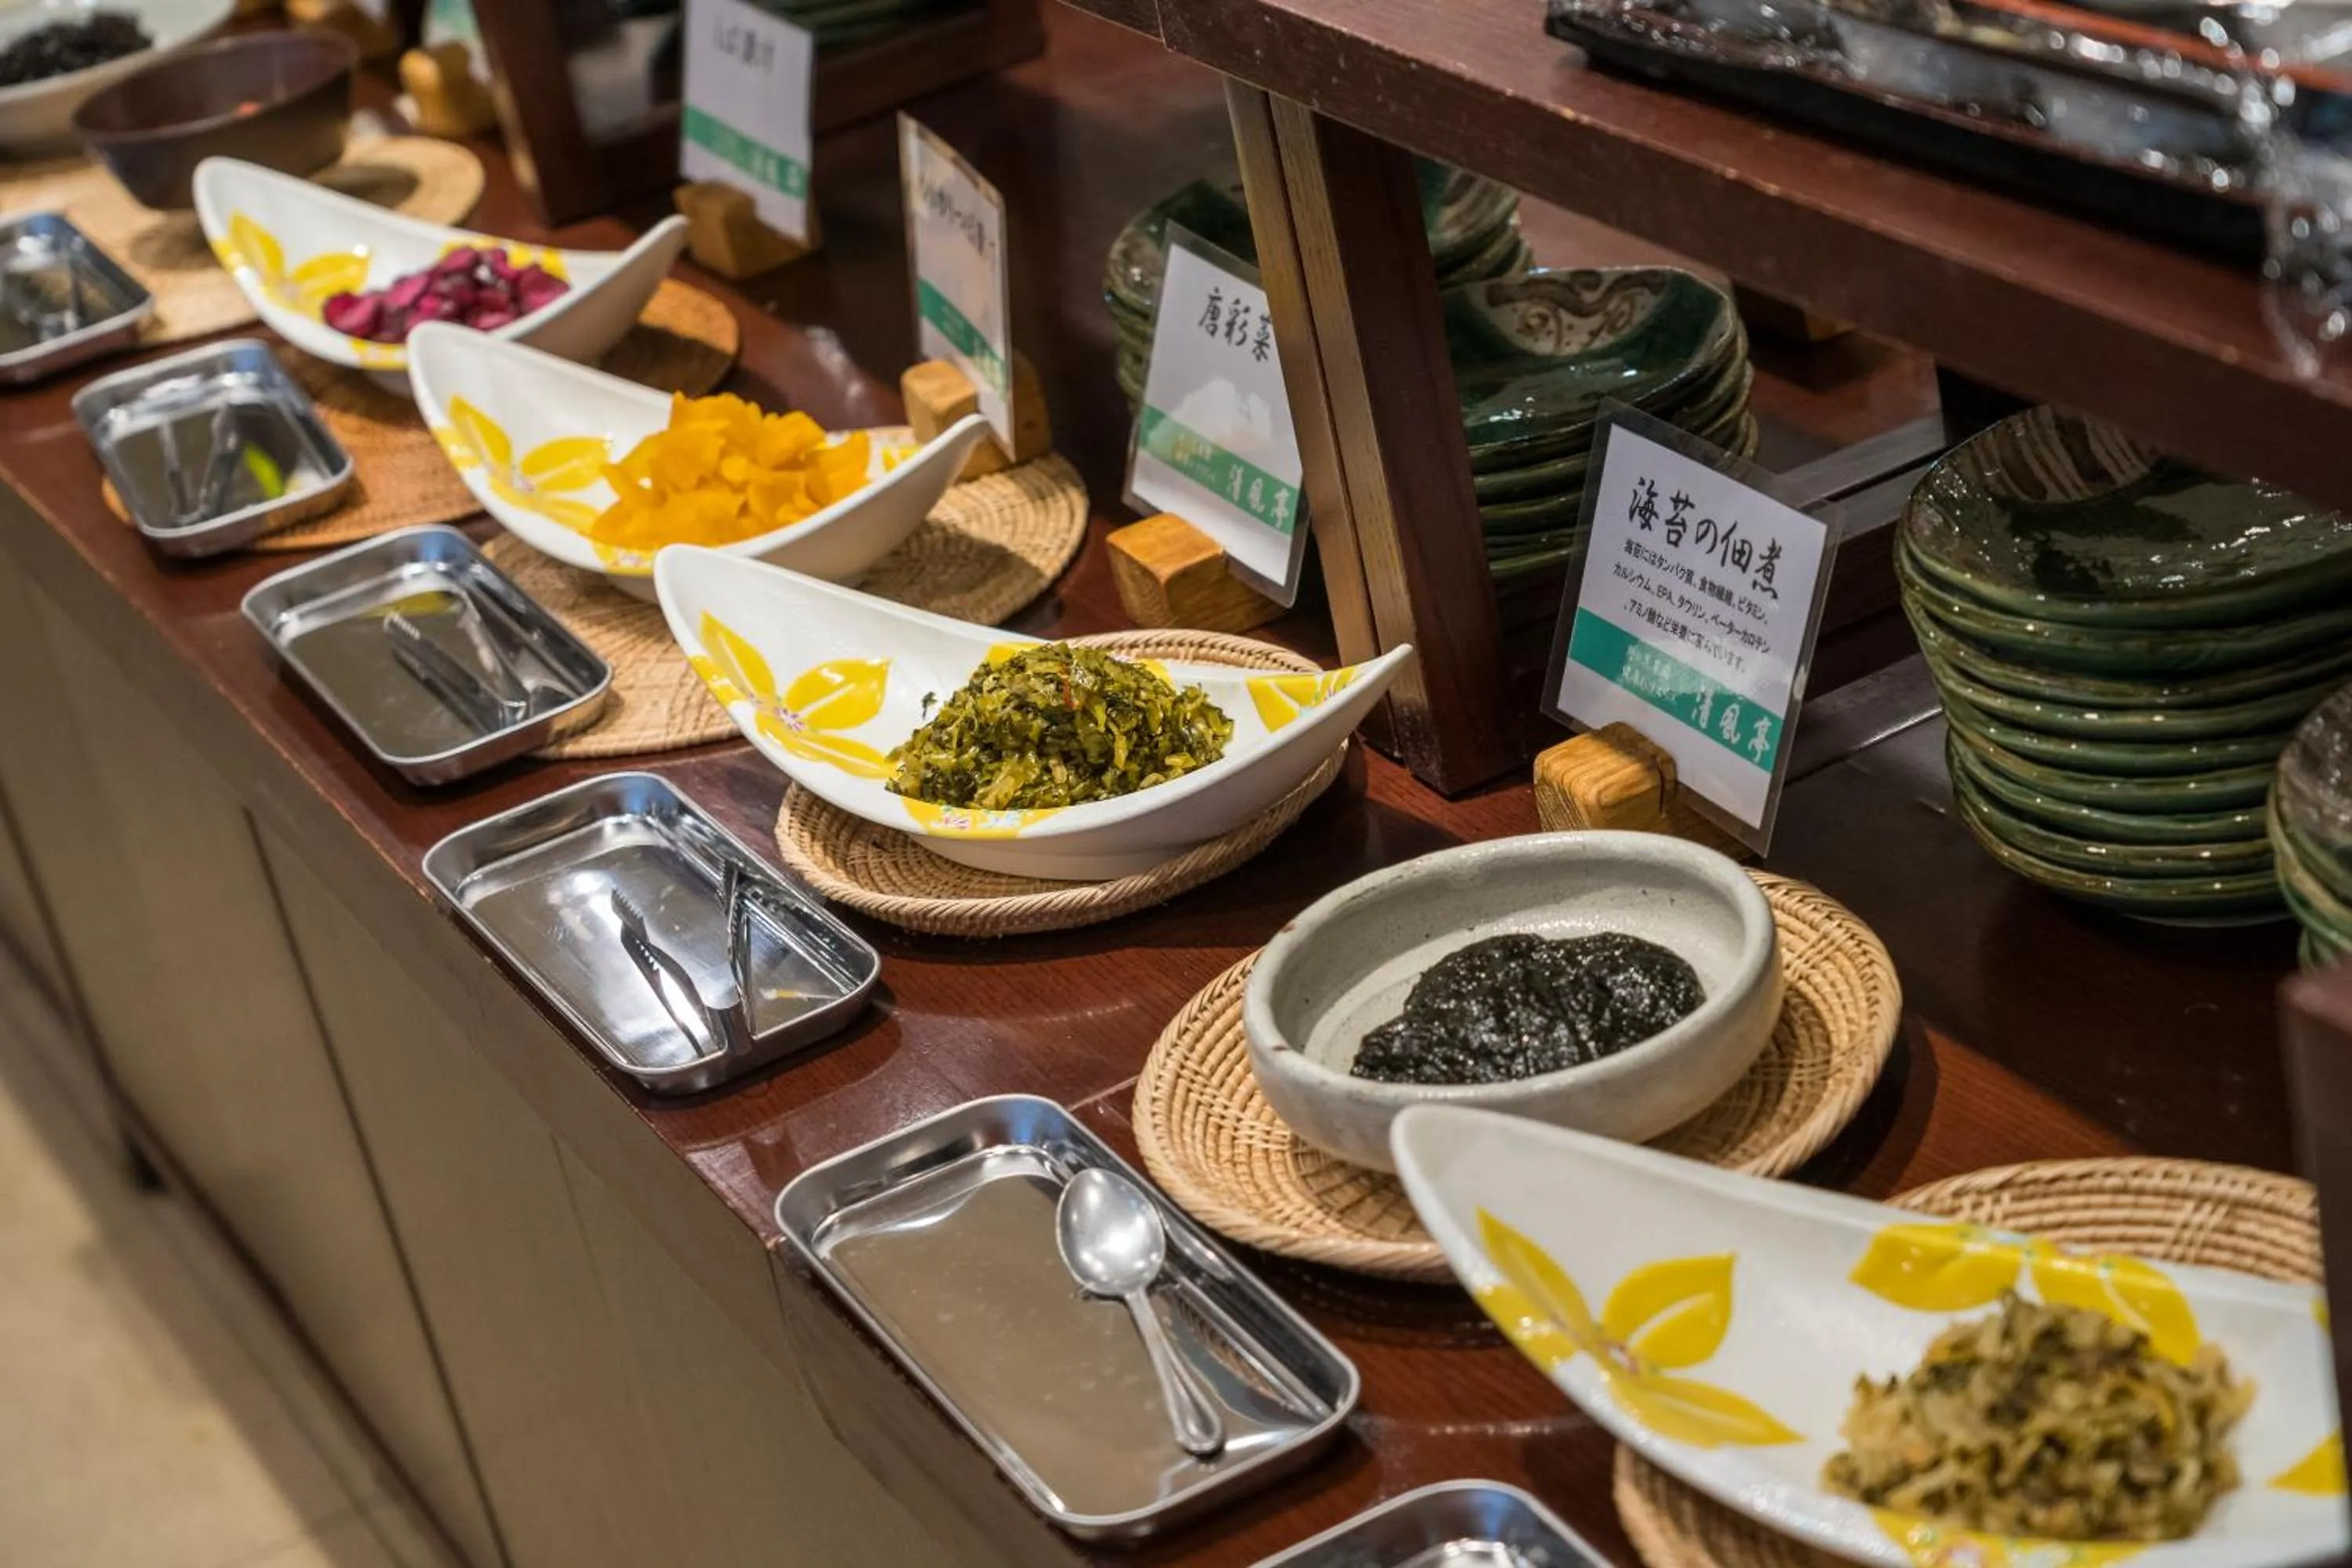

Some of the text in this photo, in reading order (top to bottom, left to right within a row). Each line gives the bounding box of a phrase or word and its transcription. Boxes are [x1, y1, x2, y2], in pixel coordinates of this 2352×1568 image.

[1628, 476, 1782, 600] 海苔の佃煮
